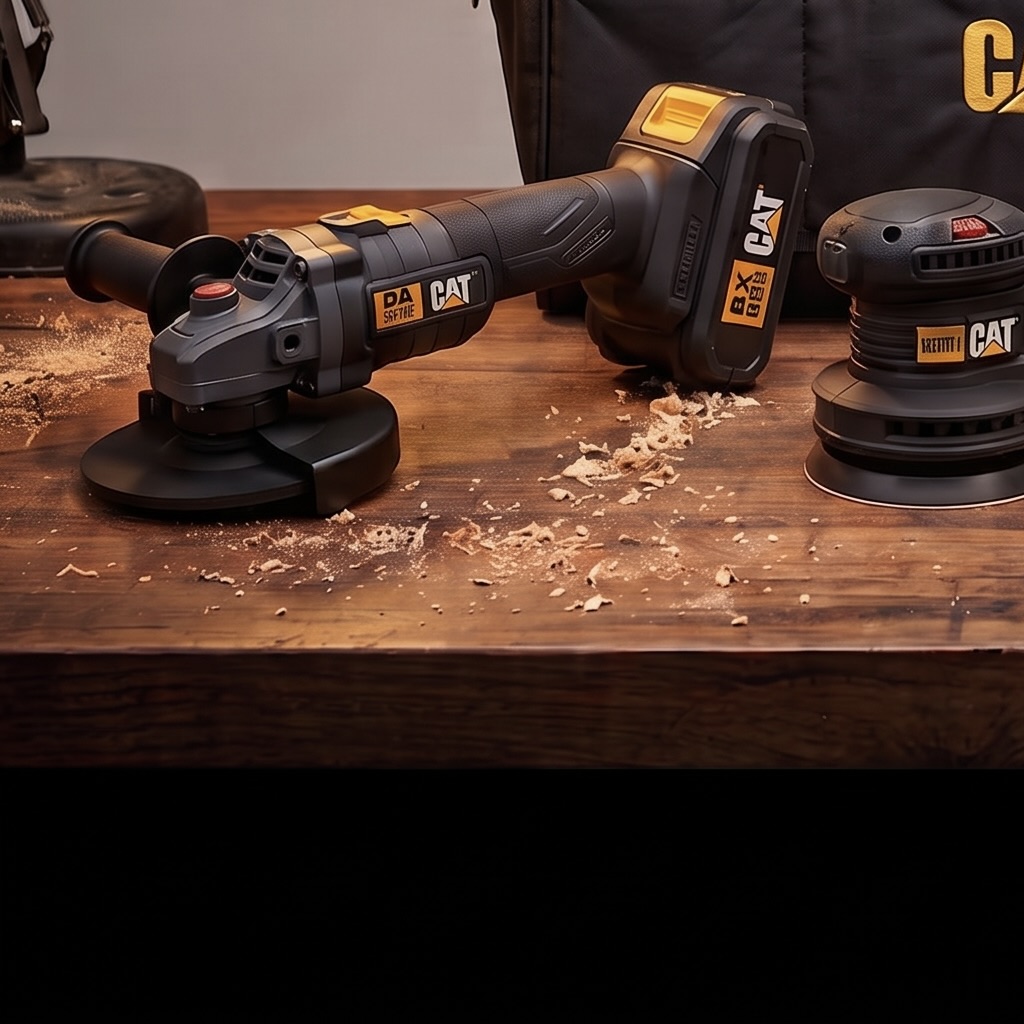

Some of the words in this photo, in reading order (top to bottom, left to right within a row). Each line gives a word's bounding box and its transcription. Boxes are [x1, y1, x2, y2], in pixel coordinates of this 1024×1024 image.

[743, 188, 785, 256] CAT
[383, 287, 414, 309] DA
[430, 274, 472, 312] CAT
[969, 317, 1017, 359] CAT
